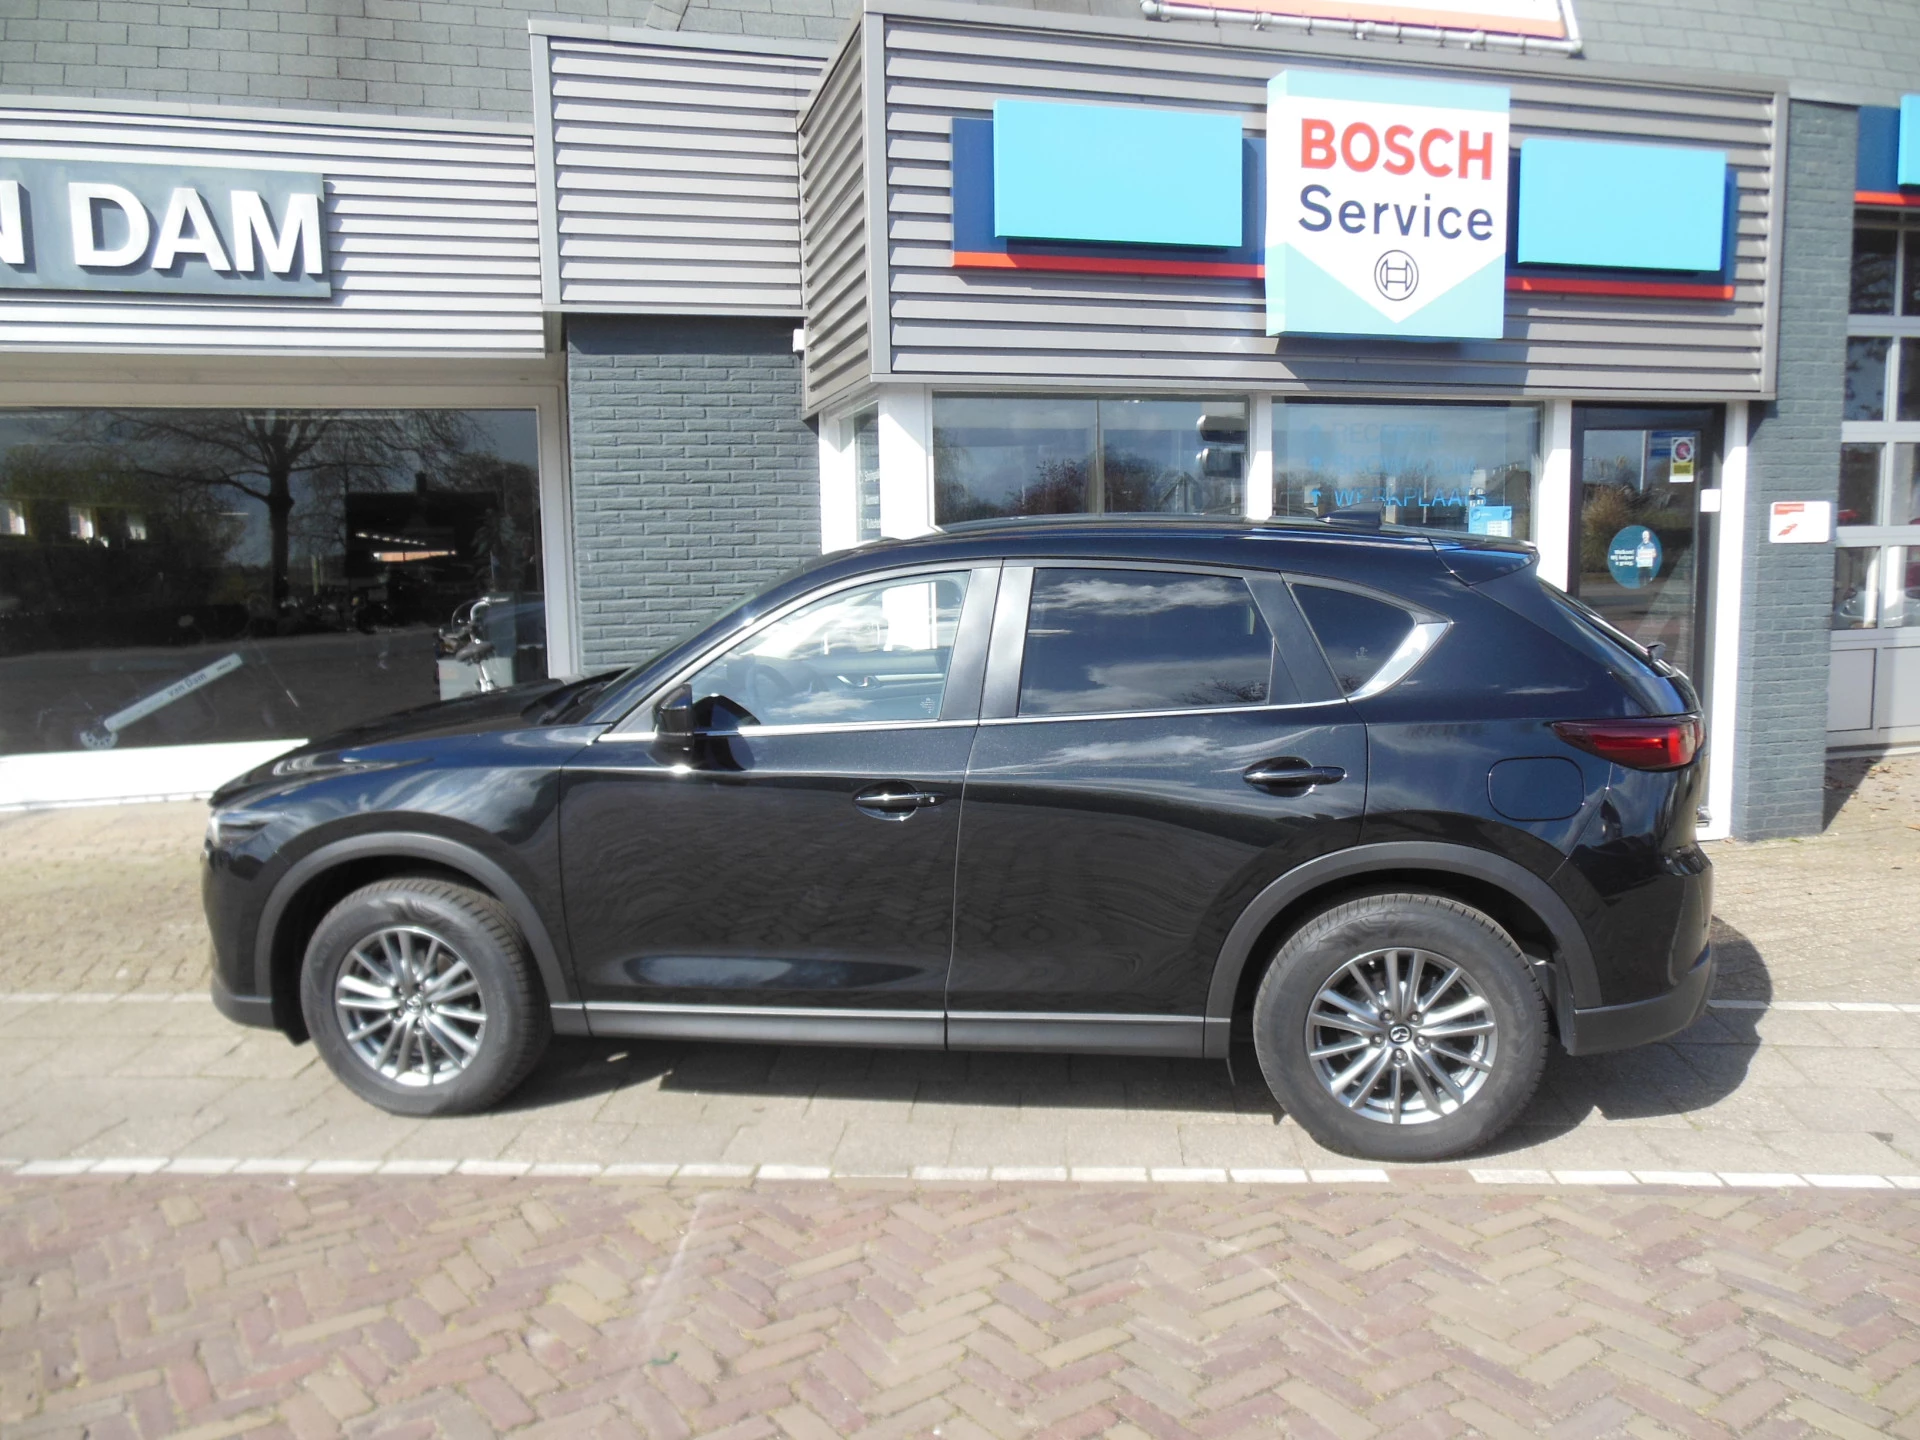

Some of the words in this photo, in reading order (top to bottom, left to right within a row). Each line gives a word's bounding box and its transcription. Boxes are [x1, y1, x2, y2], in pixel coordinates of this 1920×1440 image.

[1301, 118, 1493, 180] BOSCH
[68, 182, 323, 275] DAM
[1298, 184, 1493, 241] Service
